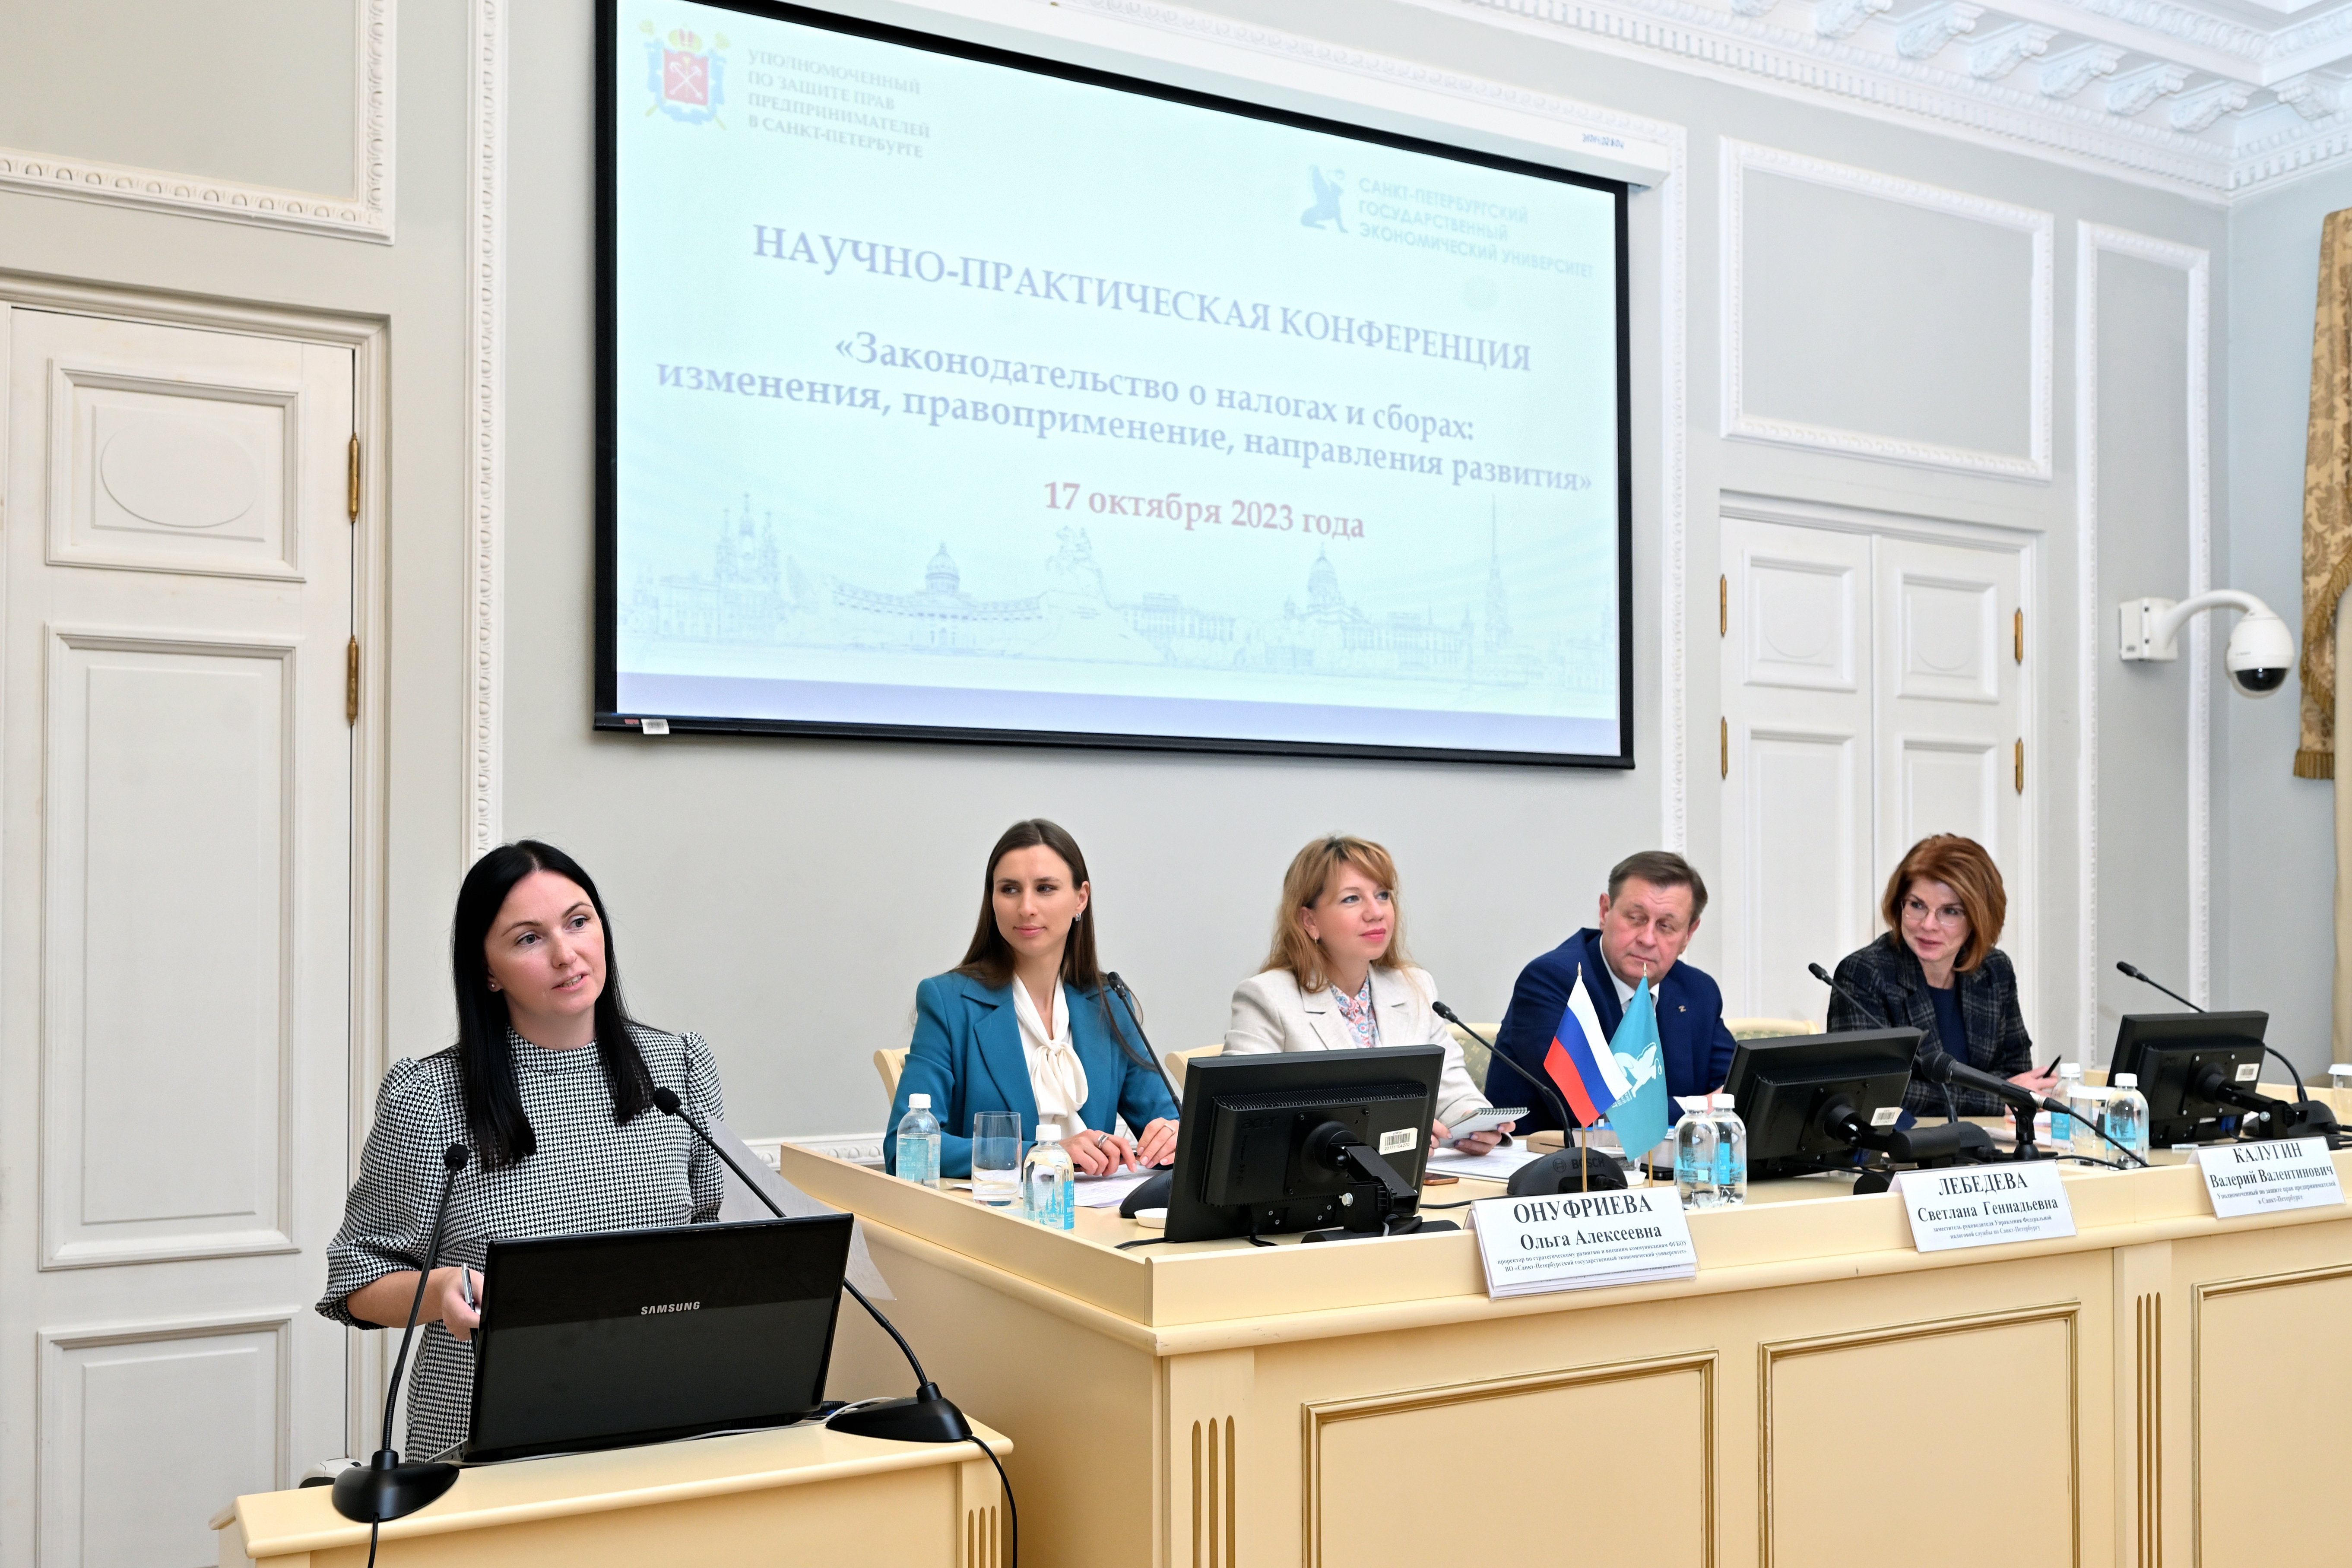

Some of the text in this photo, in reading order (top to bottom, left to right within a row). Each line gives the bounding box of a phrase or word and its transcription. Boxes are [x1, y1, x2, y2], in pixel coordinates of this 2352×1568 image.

[753, 224, 1531, 372] НАУЧНО-ПРАКТИЧЕСКАЯ КОНФЕРЕНЦИЯ
[835, 331, 1473, 443] «Законодательство о налогах и сборах:
[656, 363, 1591, 491] изменения, правоприменение, направления развития»
[1044, 481, 1365, 540] 17 октября 2023 года
[1241, 1117, 1279, 1130] acer
[1384, 1143, 1410, 1151] 20171104270
[2232, 1142, 2302, 1163] КАЛУГИН
[1939, 1172, 2028, 1195] ЛЕБЕДЕВА
[2209, 1166, 2333, 1189] Валерий Валентинович
[1513, 1194, 1652, 1223] ОНУФРИЕВА
[1918, 1199, 2058, 1222] Светлана Геннадьевна
[1520, 1226, 1662, 1250] Ольга Алексеевна
[1533, 1252, 1575, 1261] стратегическому
[1575, 1255, 1617, 1265] государственный
[1619, 1251, 1654, 1260] экономический
[1655, 1249, 1686, 1258] университет»
[641, 1301, 700, 1315] SAMSUNG
